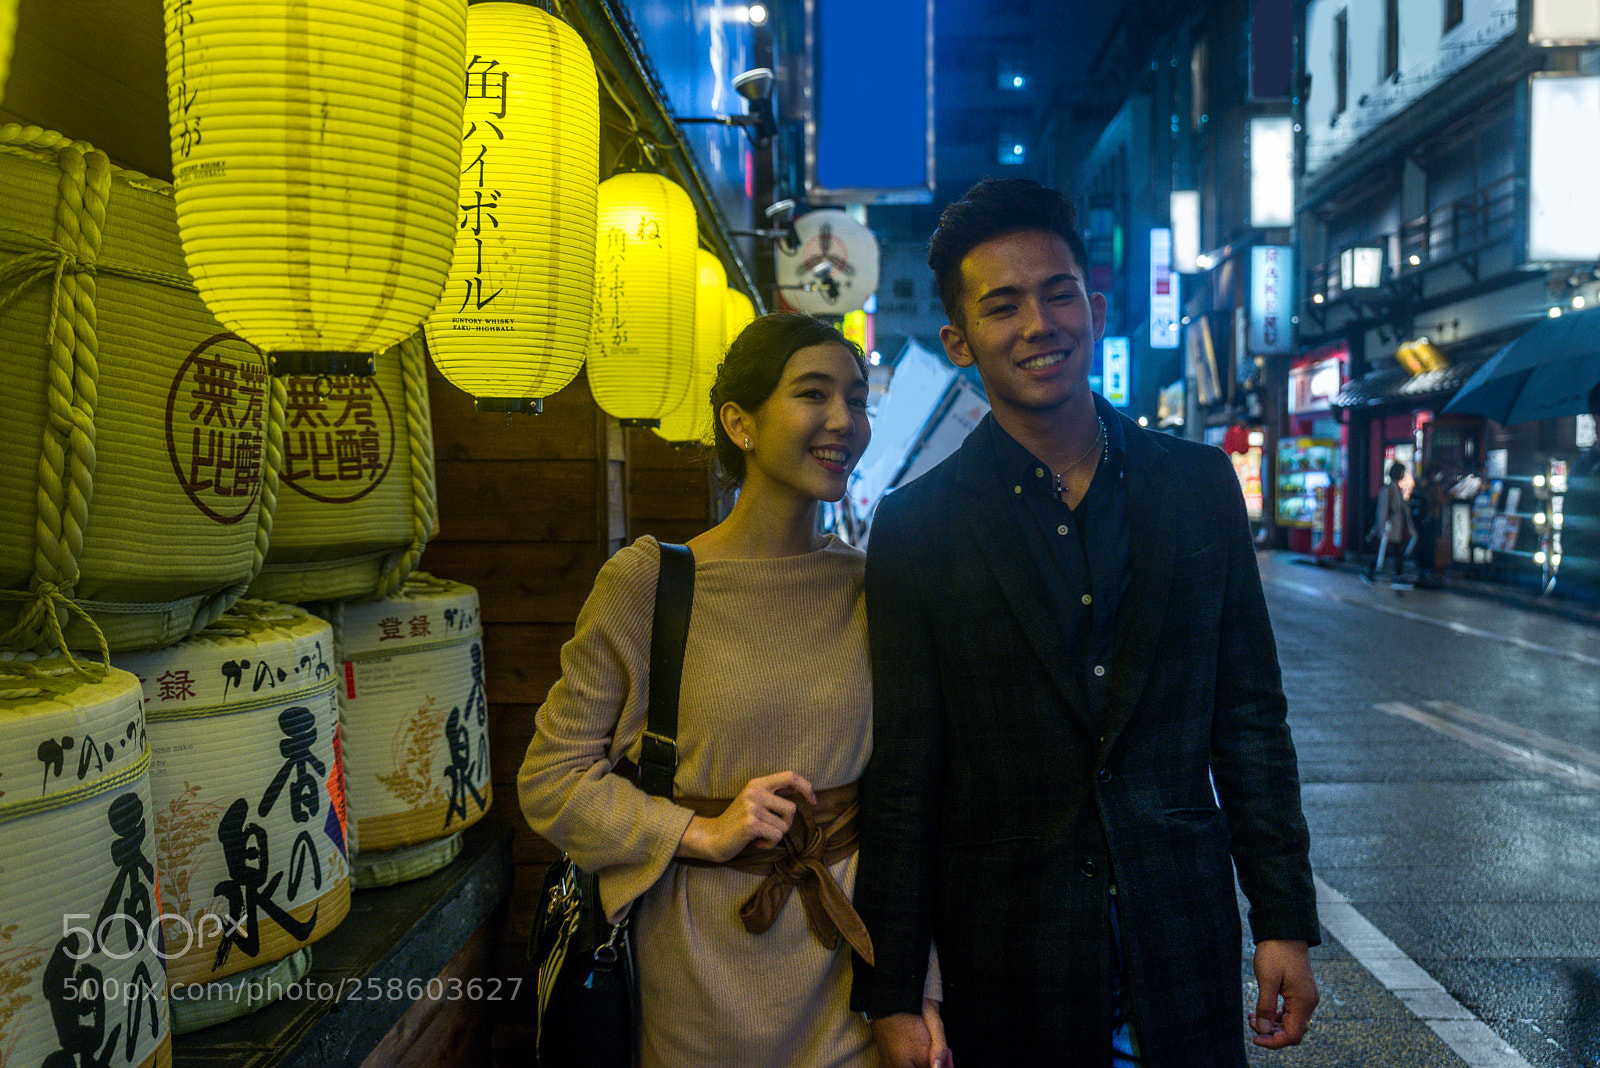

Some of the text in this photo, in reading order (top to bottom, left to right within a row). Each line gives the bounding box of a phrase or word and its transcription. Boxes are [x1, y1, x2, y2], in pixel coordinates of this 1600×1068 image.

[458, 54, 510, 314] 角ハイボール
[452, 317, 482, 325] SUNTORY
[378, 614, 432, 642] 登録
